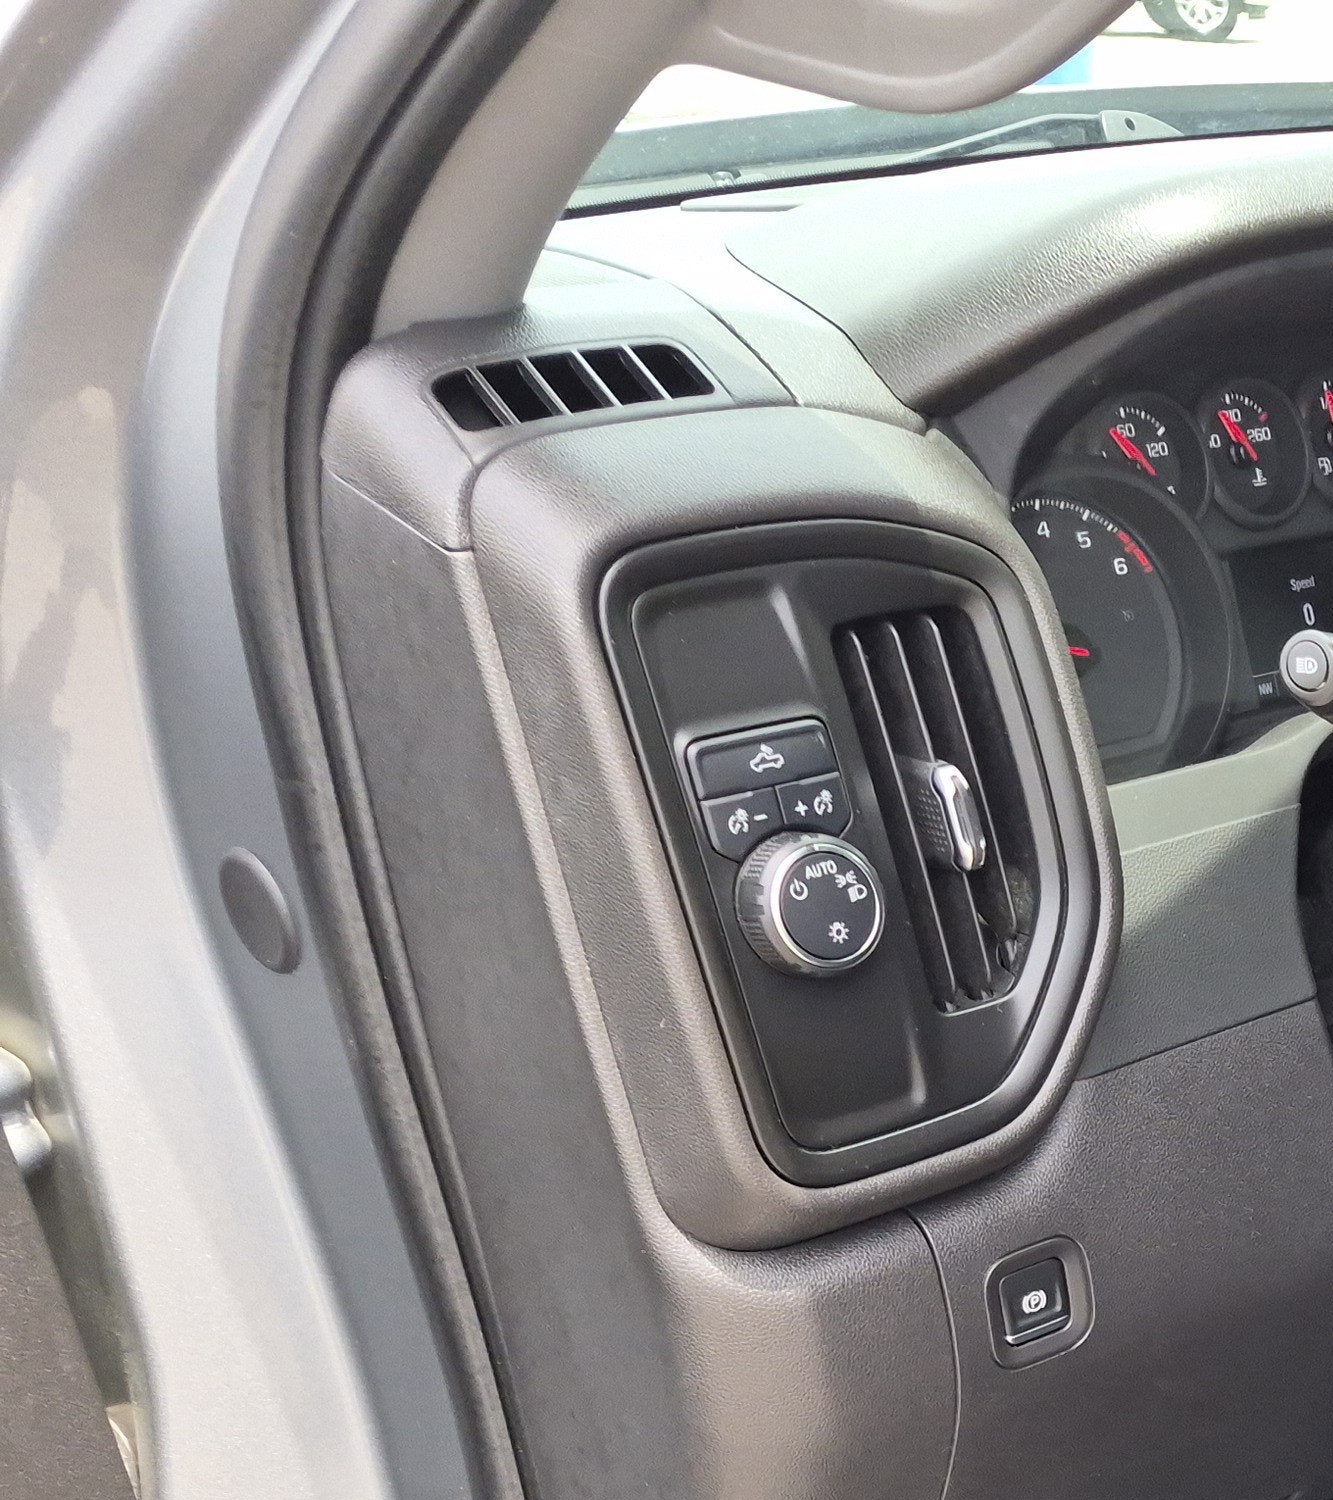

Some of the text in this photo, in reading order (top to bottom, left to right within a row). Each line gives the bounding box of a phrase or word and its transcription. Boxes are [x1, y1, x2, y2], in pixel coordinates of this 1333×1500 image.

[1246, 426, 1272, 443] 260
[1145, 441, 1169, 458] 120
[1036, 520, 1051, 539] 4
[1075, 530, 1092, 549] 5
[1113, 557, 1129, 576] 6
[1289, 575, 1316, 592] Speed
[1302, 601, 1316, 627] 0
[1258, 681, 1273, 696] NW
[805, 859, 837, 881] AUTO
